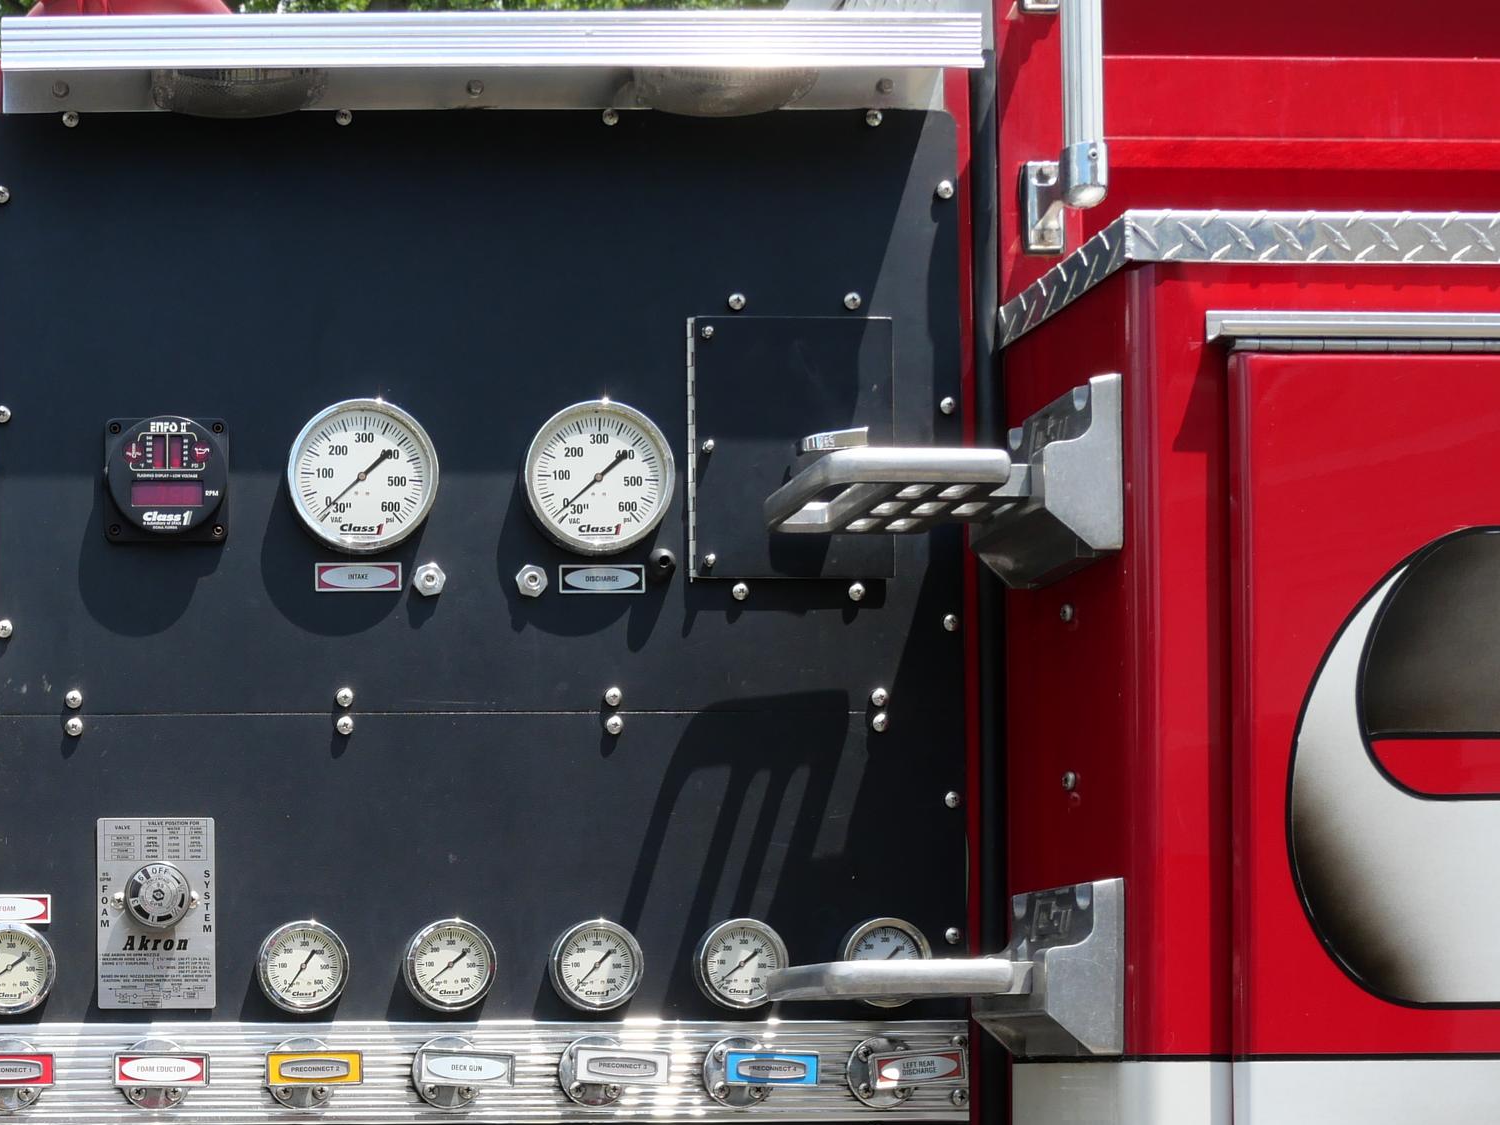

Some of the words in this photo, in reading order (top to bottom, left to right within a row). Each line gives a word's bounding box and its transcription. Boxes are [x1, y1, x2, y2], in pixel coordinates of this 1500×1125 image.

[355, 433, 374, 443] 300
[590, 434, 609, 444] 300
[329, 445, 348, 456] 200
[564, 447, 584, 458] 200
[316, 468, 334, 478] 100
[552, 470, 571, 480] 100
[387, 476, 407, 487] 500
[624, 477, 643, 487] 500
[381, 502, 401, 512] 600
[618, 502, 638, 512] 600
[330, 516, 343, 524] VAC
[386, 516, 394, 524] psi
[340, 524, 384, 536] Class1
[578, 524, 622, 536] Class1
[348, 573, 369, 581] INTAKE
[123, 936, 189, 951] Akron
[599, 1062, 642, 1070] PRECONNECT
[902, 1067, 938, 1076] DISCHARGE
